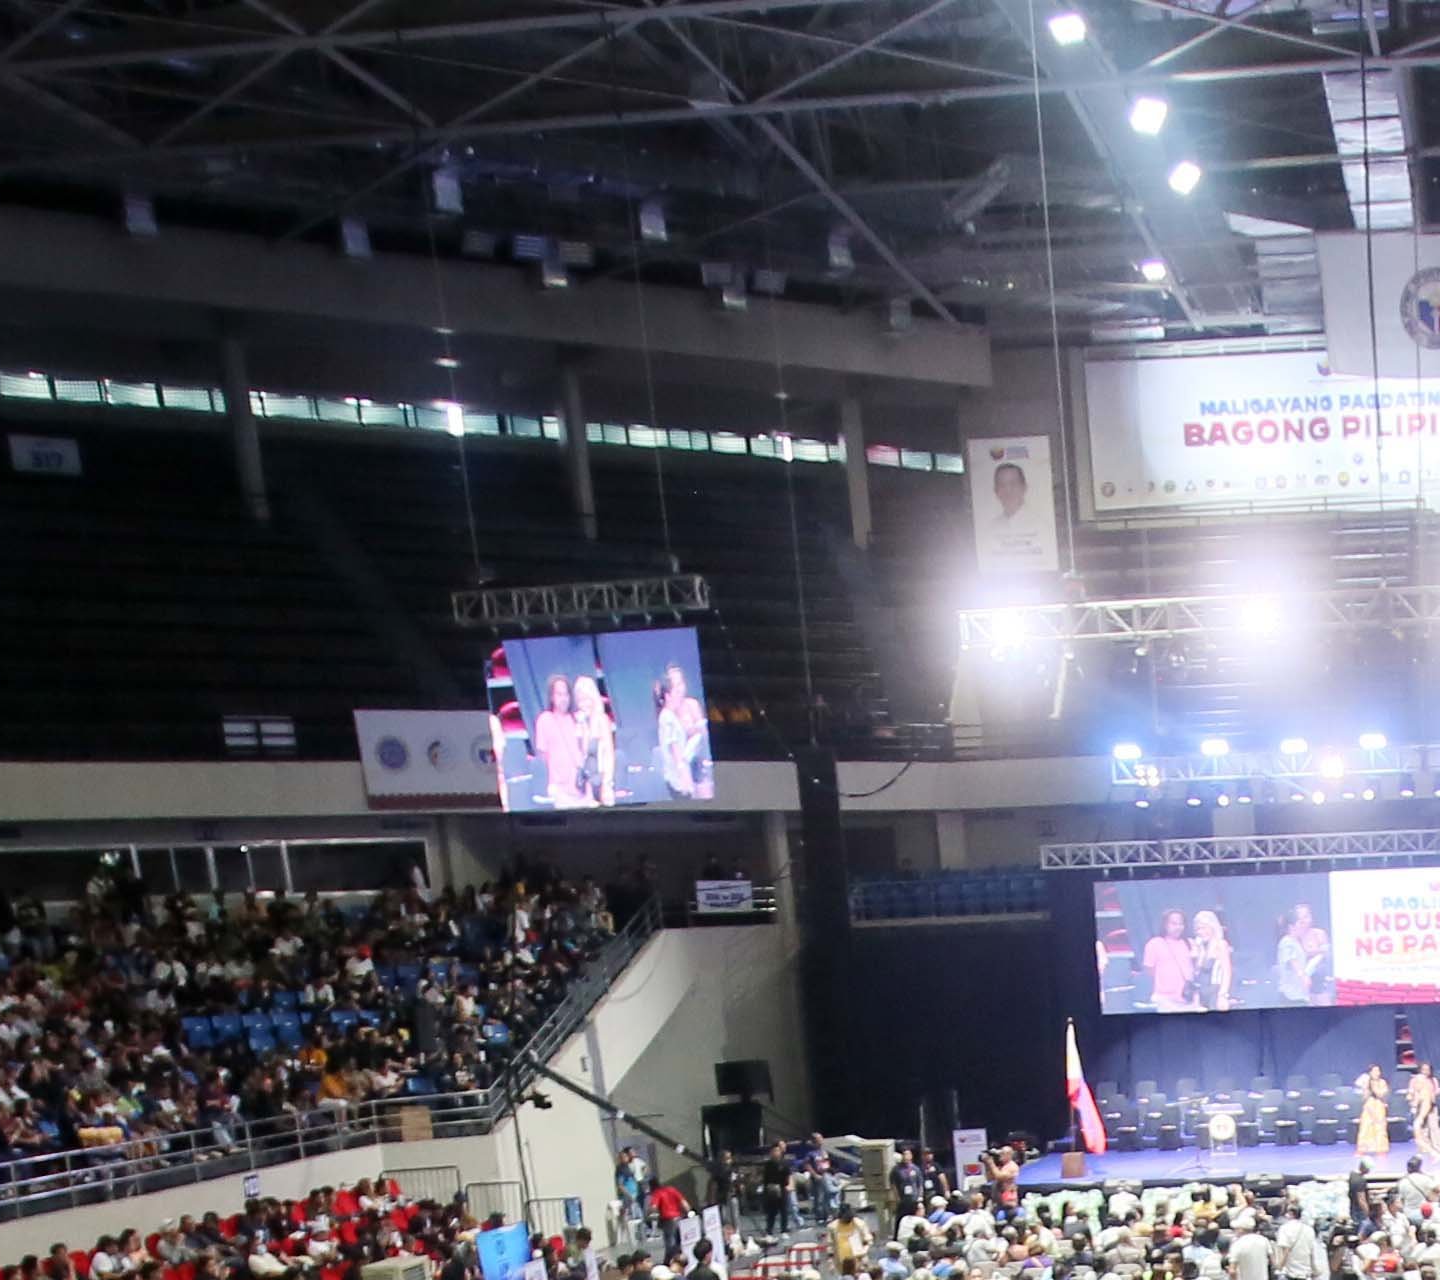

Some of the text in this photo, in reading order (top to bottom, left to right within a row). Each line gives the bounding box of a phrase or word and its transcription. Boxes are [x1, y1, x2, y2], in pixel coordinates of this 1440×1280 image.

[1200, 396, 1334, 416] MALIGAYANG
[1183, 417, 1331, 447] BAGONG
[1355, 936, 1394, 956] NG
